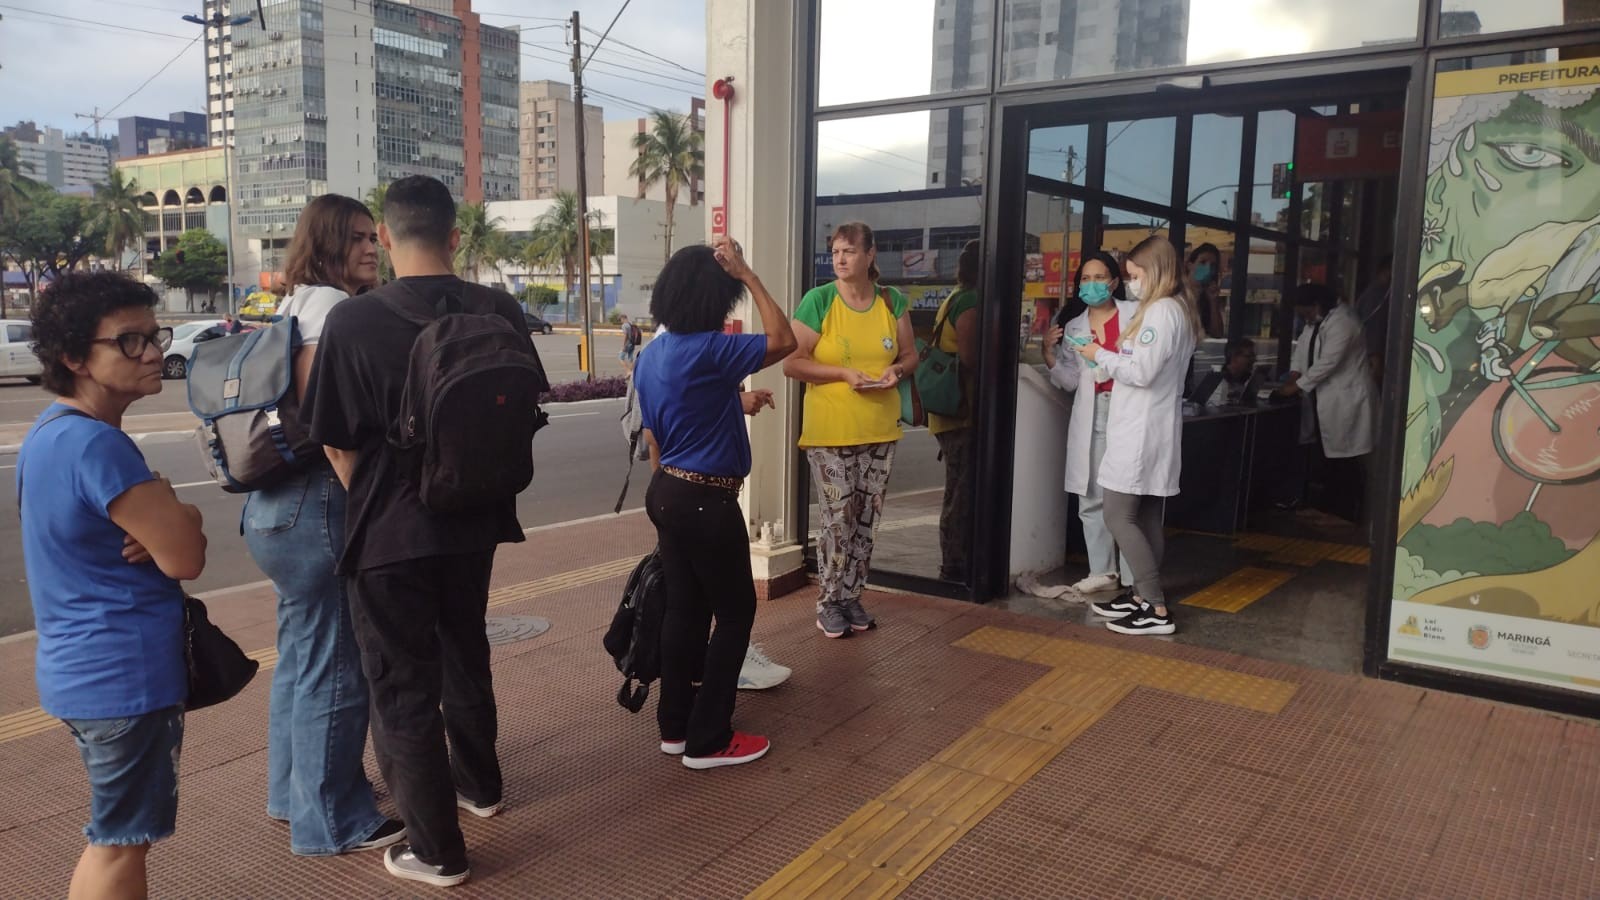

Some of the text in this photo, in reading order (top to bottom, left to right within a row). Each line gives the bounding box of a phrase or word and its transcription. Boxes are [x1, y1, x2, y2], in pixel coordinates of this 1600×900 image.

[1498, 65, 1600, 85] PREFEITURA
[1424, 617, 1437, 625] Lei
[1423, 625, 1443, 633] Aldir
[1497, 631, 1551, 647] MARINGÁ
